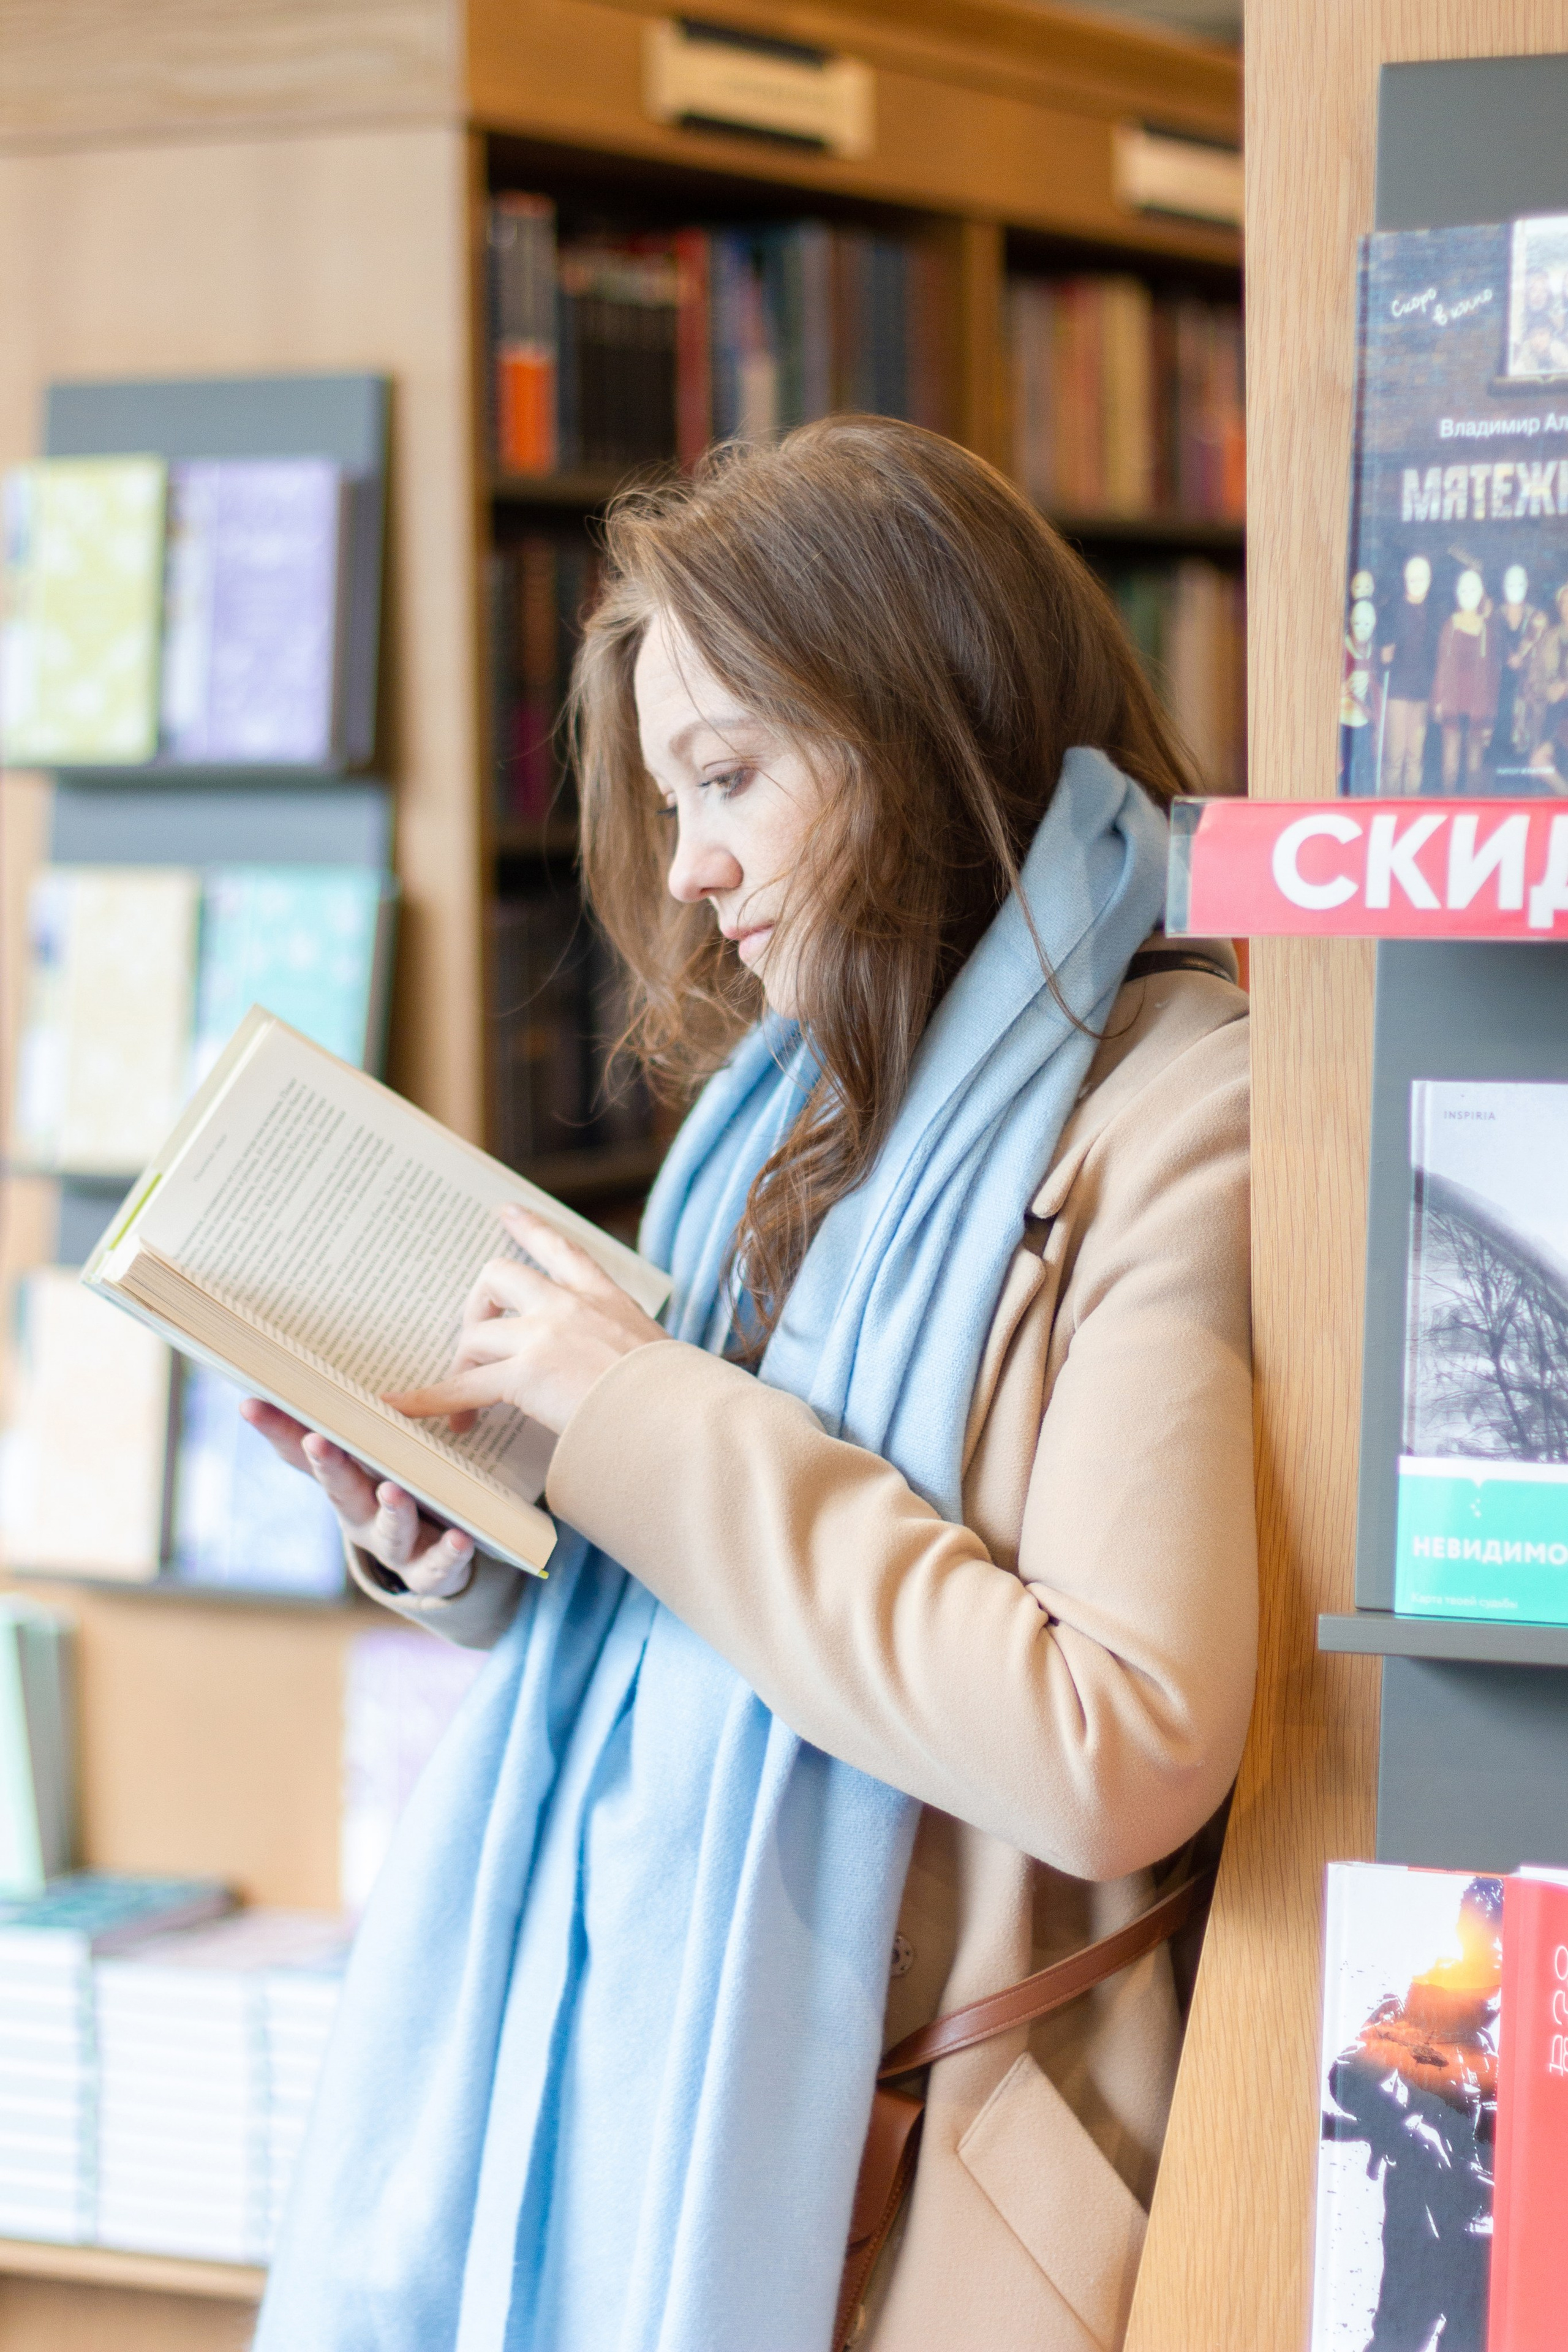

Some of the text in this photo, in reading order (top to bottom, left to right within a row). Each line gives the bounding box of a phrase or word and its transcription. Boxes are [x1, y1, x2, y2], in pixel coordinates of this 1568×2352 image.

[1391, 287, 1437, 318] Скоро
[1450, 288, 1493, 318] кино
[1439, 417, 1541, 439] Владимир
[1444, 1110, 1496, 1121] INSPIRIA
[1412, 1535, 1568, 1565] НЕВИДИМО
[1411, 1592, 1518, 1610] Карта твоей судьбы
